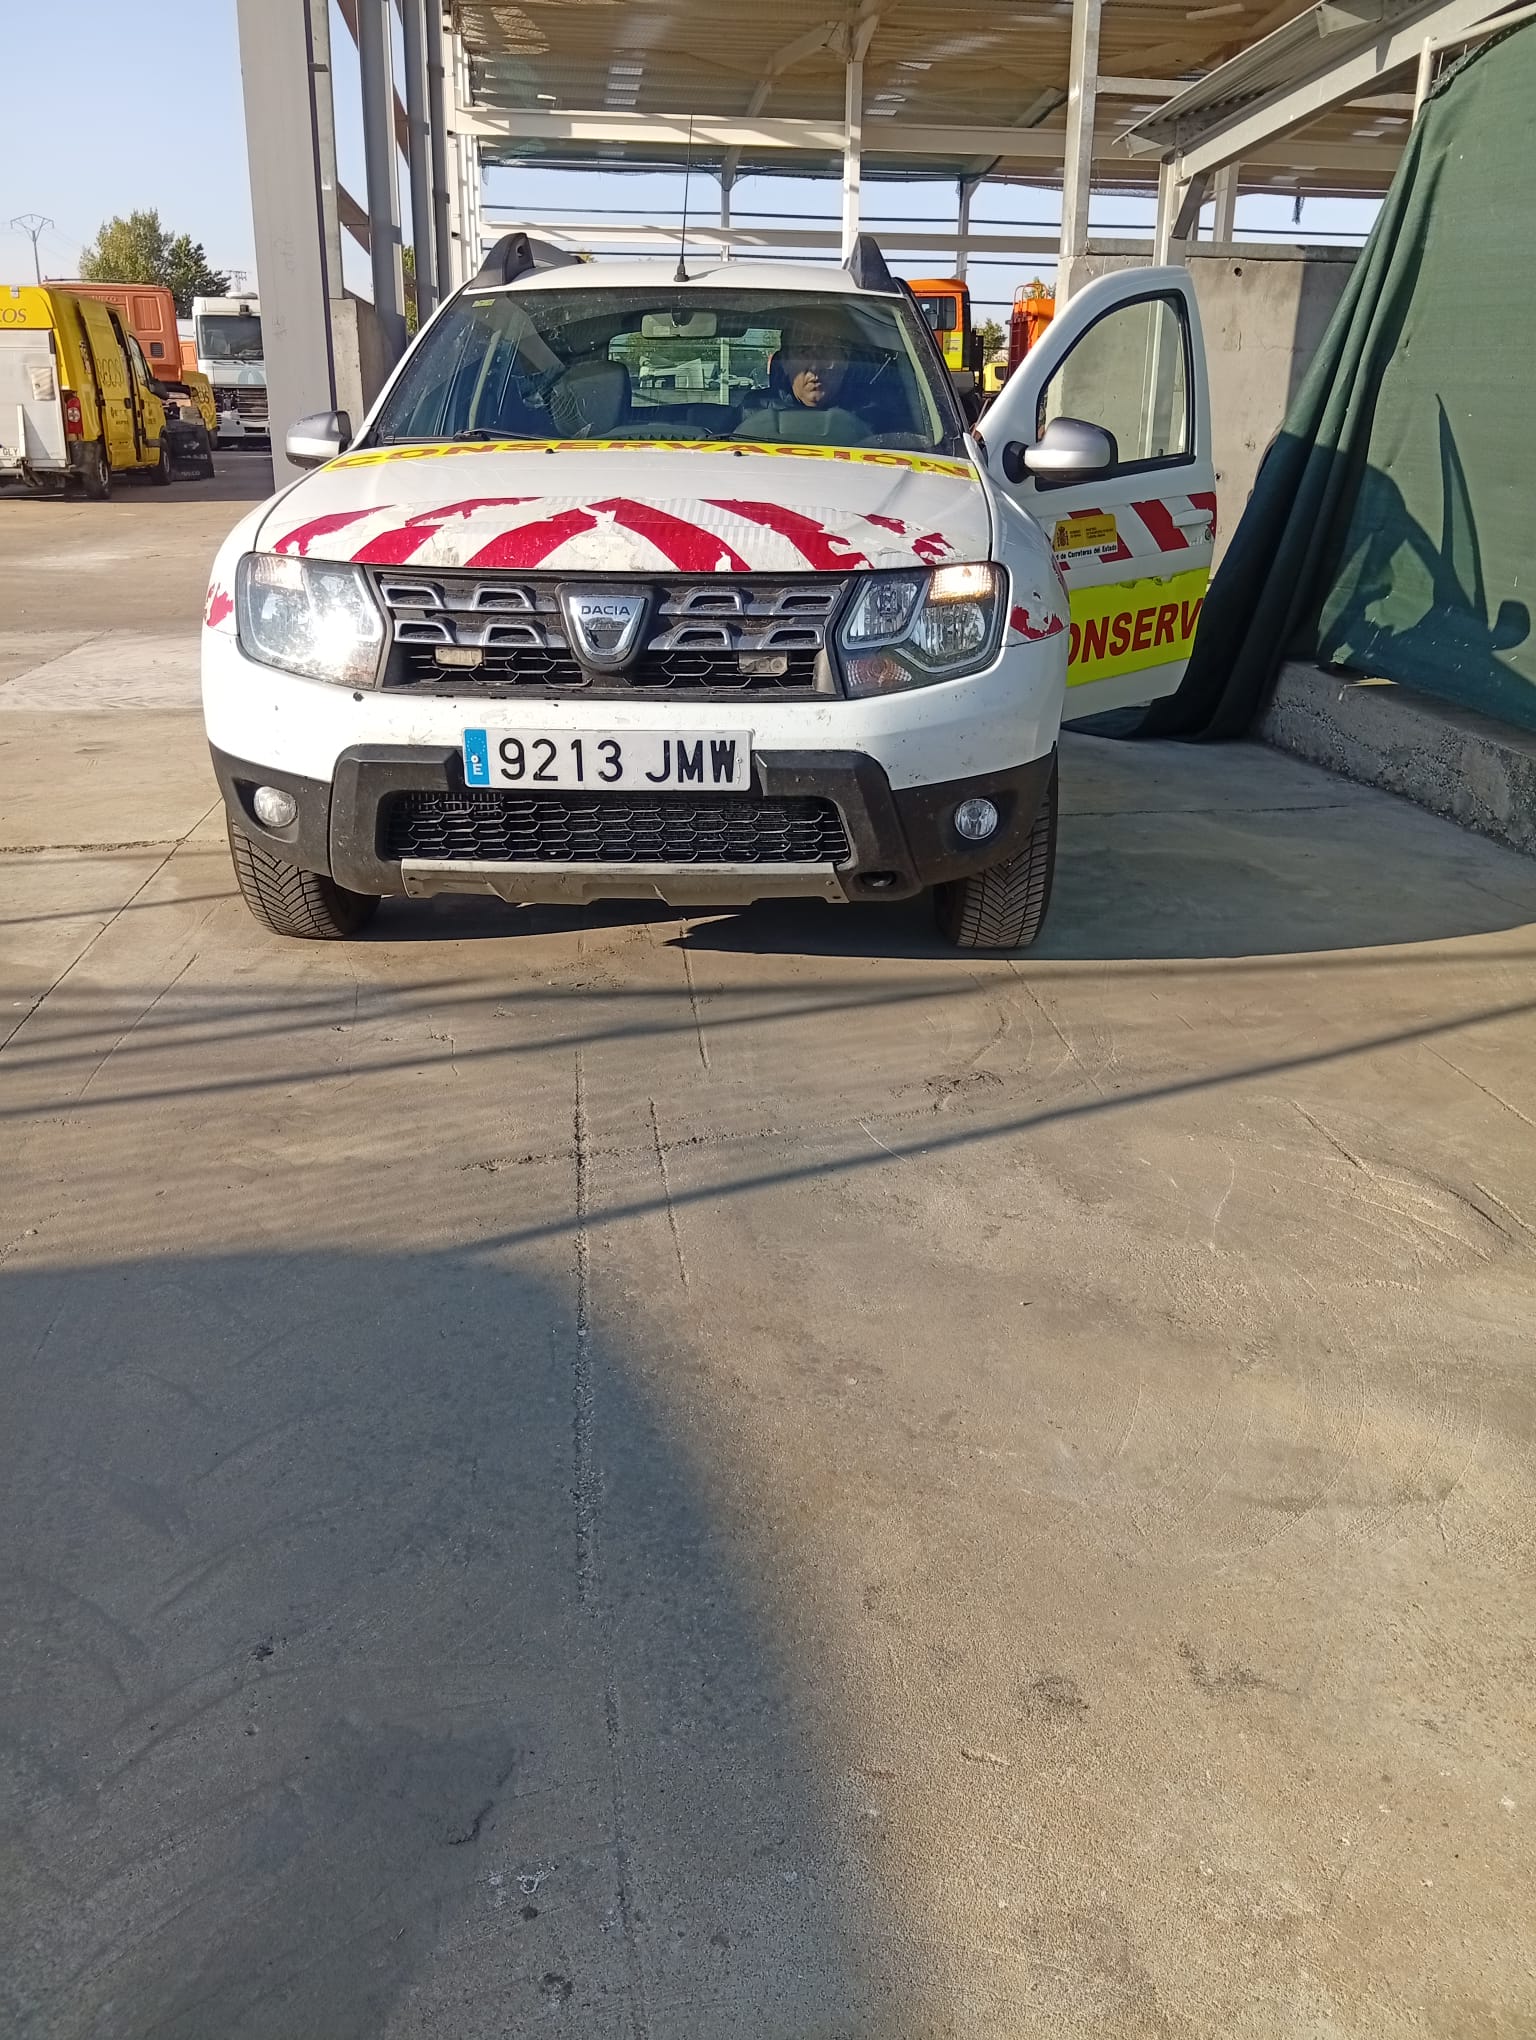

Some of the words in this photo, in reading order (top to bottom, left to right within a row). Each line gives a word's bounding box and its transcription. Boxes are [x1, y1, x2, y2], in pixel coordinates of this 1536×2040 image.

[1067, 549, 1092, 559] Carreteras
[1093, 546, 1101, 554] del
[581, 605, 631, 616] DACIA
[499, 737, 624, 783] 9213
[645, 739, 736, 783] JMW
